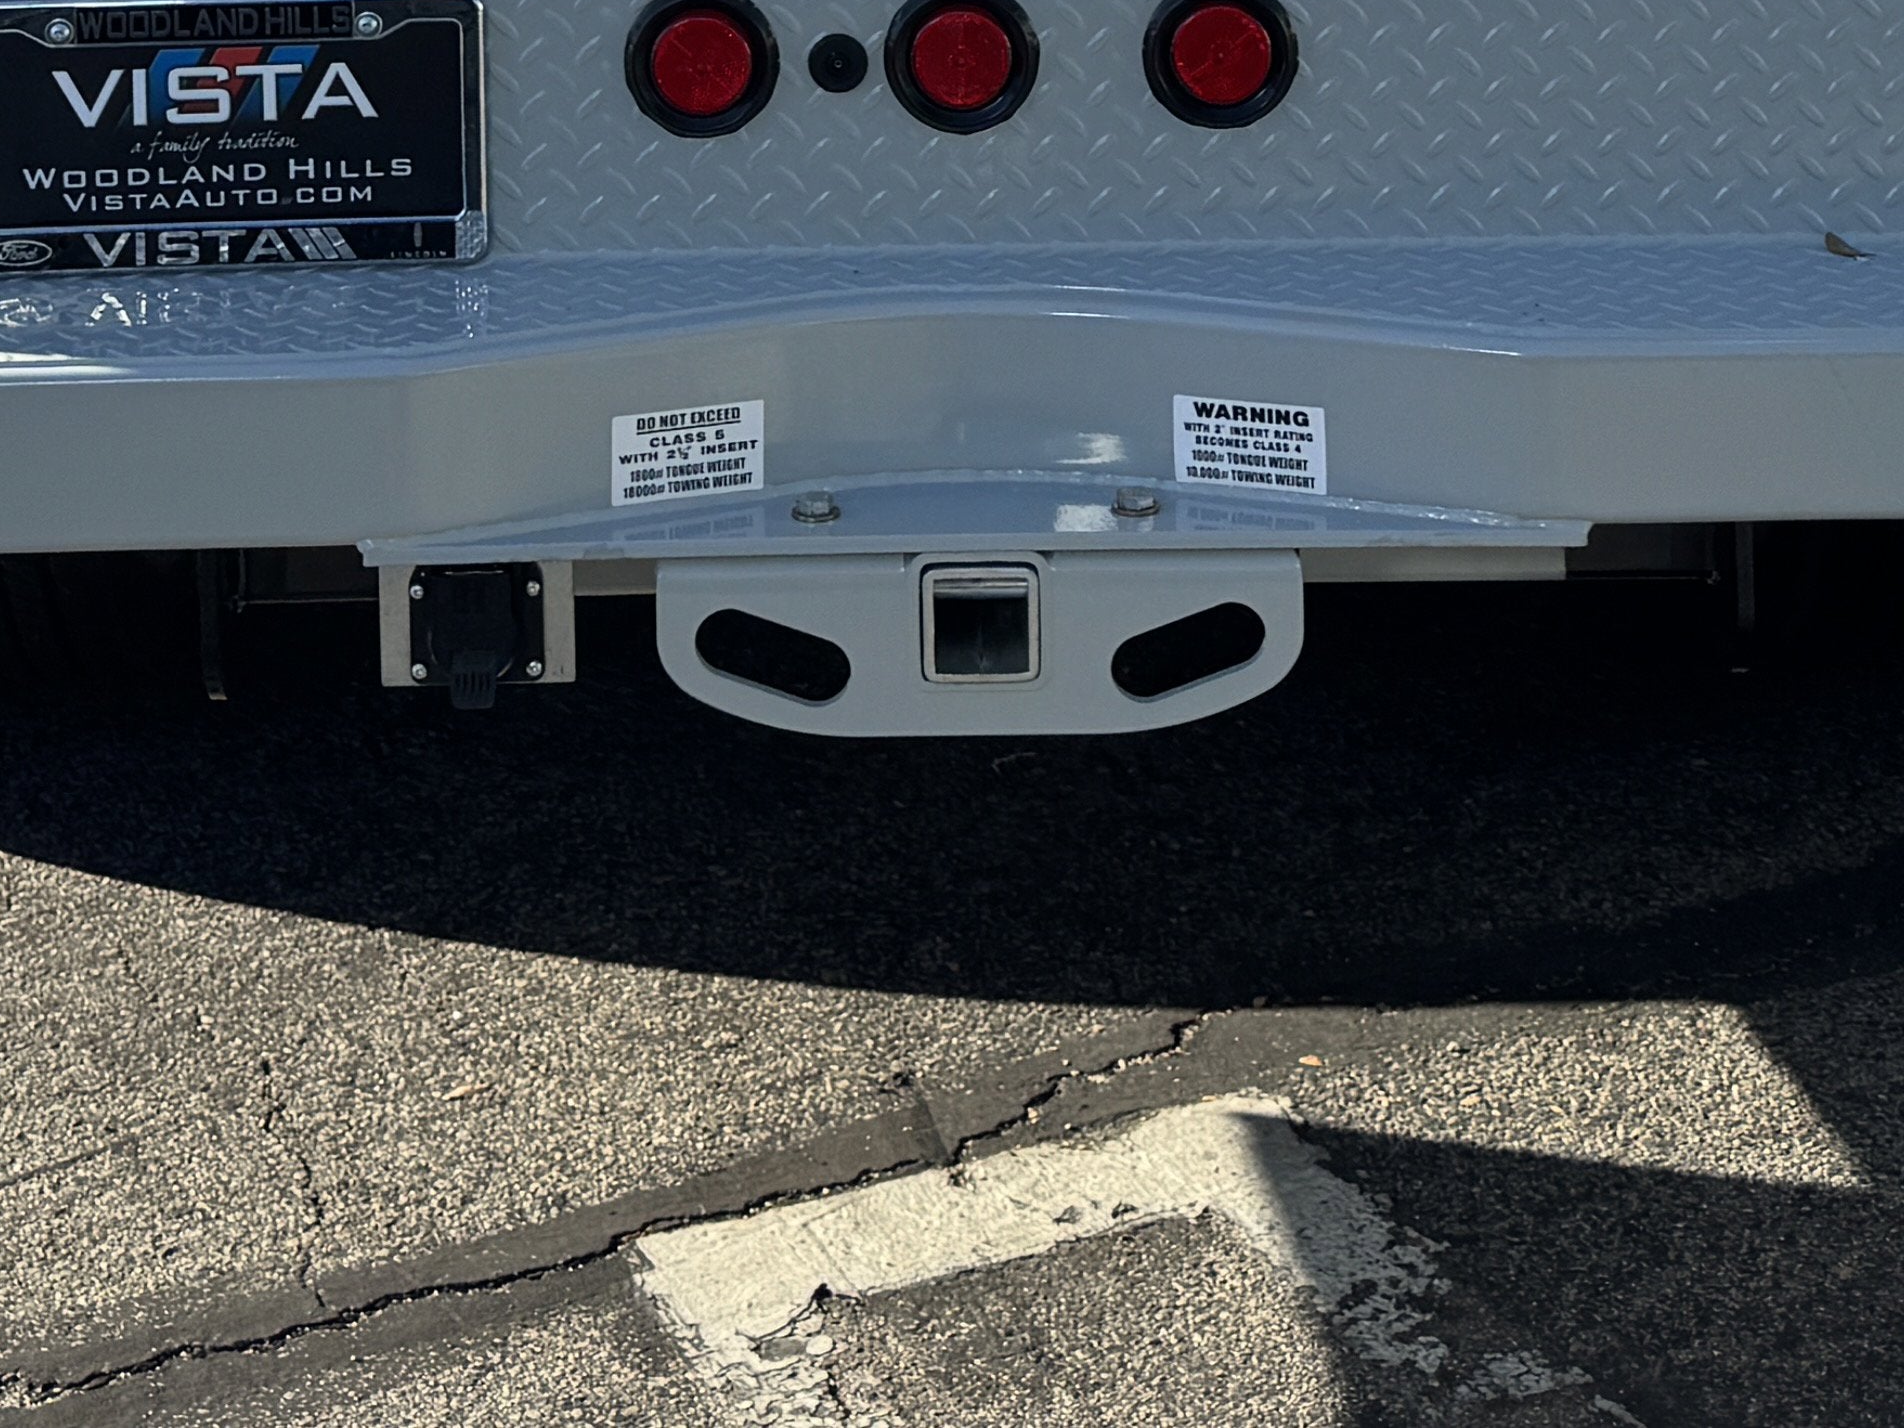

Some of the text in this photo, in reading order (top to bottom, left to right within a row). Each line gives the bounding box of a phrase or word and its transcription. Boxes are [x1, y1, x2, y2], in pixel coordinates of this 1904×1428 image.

[78, 5, 351, 40] WOODLAND HILLS
[51, 62, 379, 129] VISTA
[147, 130, 211, 164] family
[217, 129, 300, 151] tradition
[82, 228, 296, 268] VISTA
[636, 406, 741, 431] DO NOT EXCEED
[1192, 401, 1310, 428] WARNING
[649, 429, 725, 448] CLASS 5
[1183, 421, 1211, 434] WITH
[1229, 426, 1270, 439] INSERT
[1273, 429, 1314, 443] RATING
[1195, 434, 1302, 454] BECOMES CLASS 4
[618, 451, 659, 465] WITH
[700, 439, 759, 456] INSERT
[1227, 451, 1267, 468] TONGUE
[1268, 455, 1309, 472] WEIGHT
[666, 462, 705, 479] TONGUE
[706, 456, 746, 474] WEIGHT
[1231, 469, 1274, 486] TOWING
[1274, 473, 1316, 489] WEIGHT
[668, 476, 711, 494] TOWING
[712, 471, 754, 489] WEIGHT
